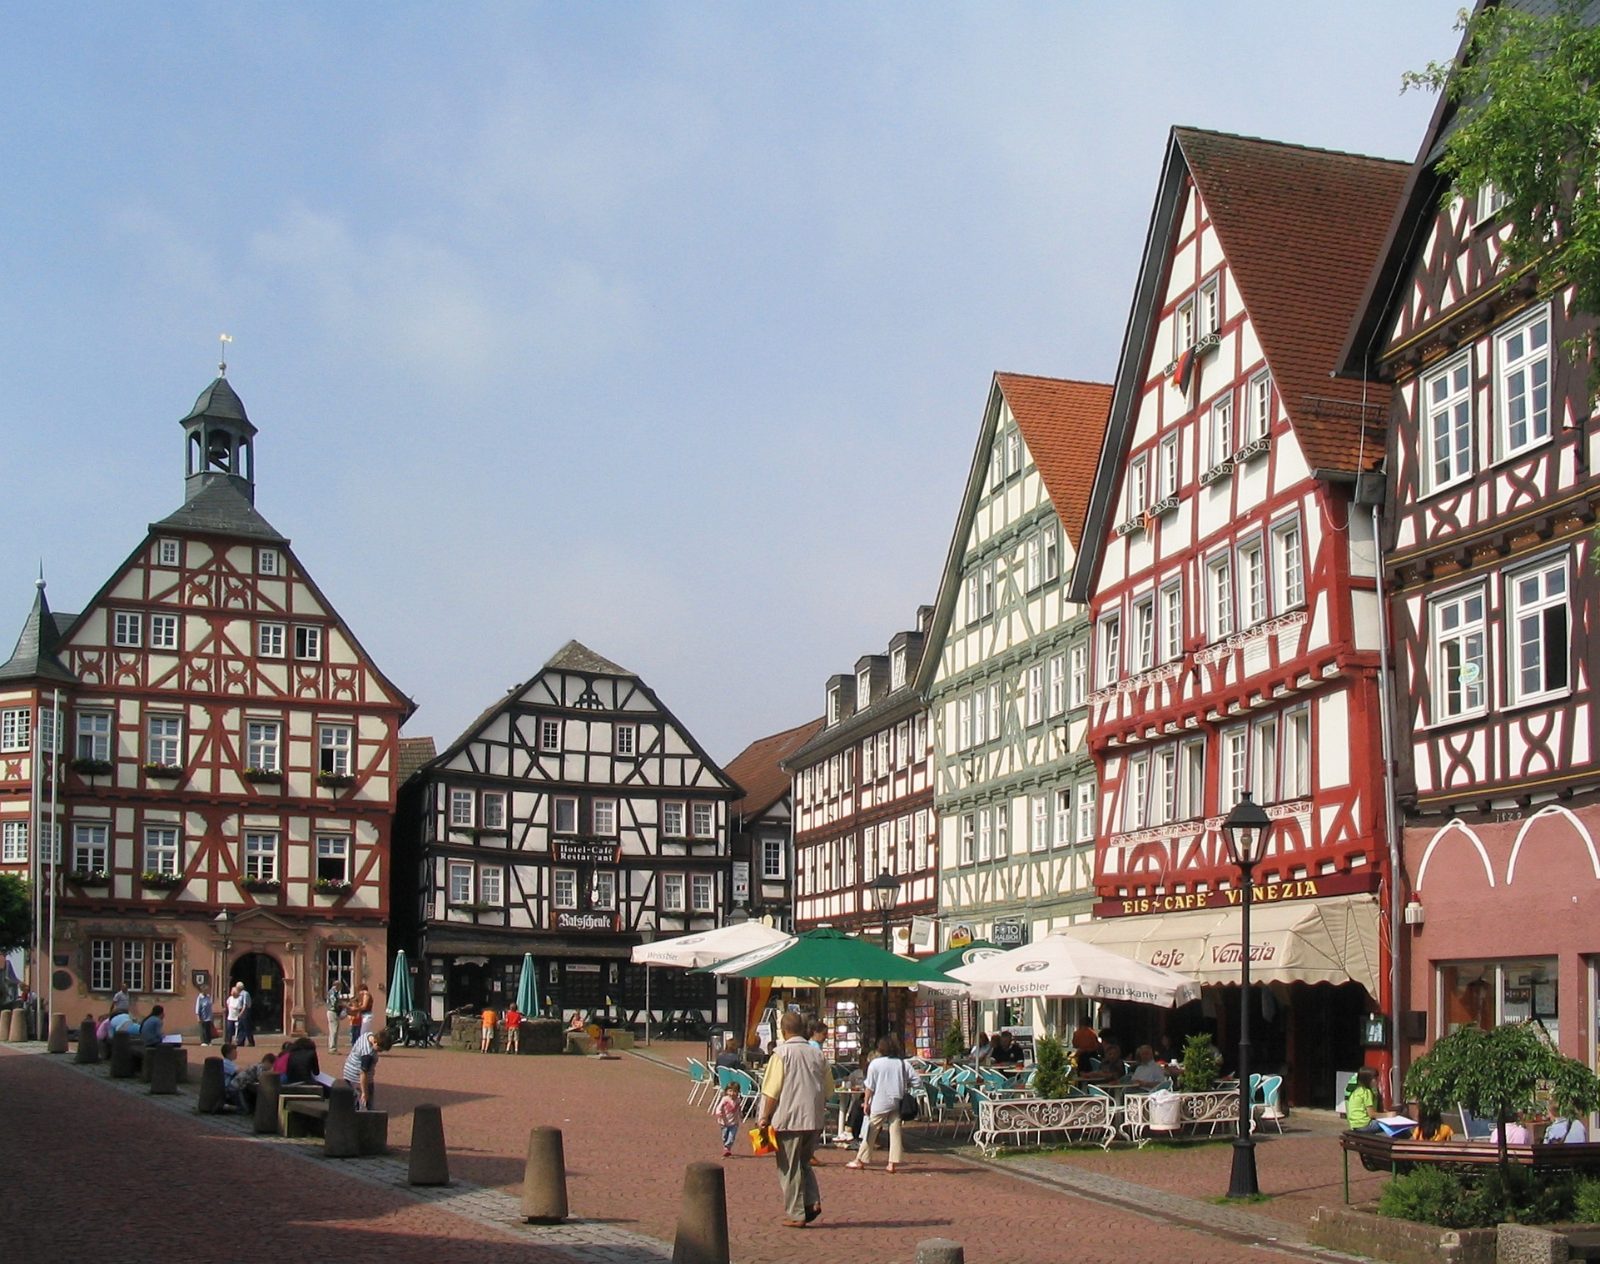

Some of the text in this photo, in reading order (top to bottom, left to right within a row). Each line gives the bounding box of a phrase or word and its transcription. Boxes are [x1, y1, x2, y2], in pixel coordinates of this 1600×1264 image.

[560, 844, 613, 854] Hotel-Café
[1151, 948, 1185, 968] Cafe
[999, 982, 1050, 994] Weissbier
[1097, 984, 1159, 1001] Franziskaner
